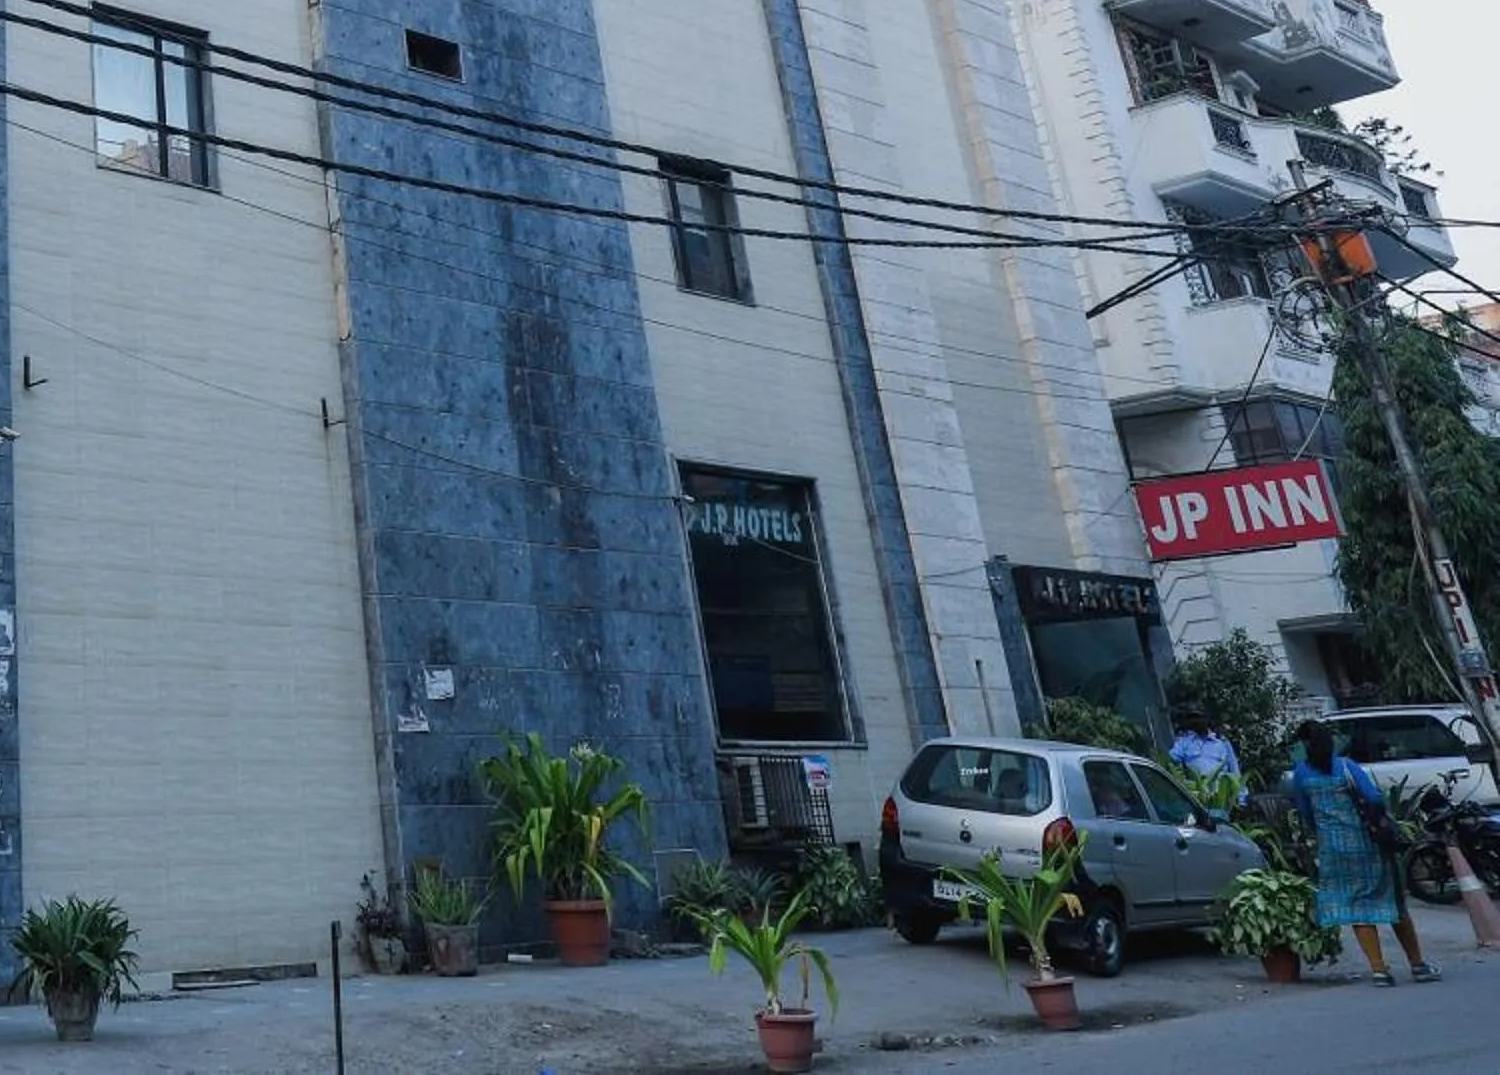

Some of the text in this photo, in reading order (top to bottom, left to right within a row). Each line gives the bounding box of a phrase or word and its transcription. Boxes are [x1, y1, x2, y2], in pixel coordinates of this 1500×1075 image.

[733, 505, 802, 542] HOTELS
[1151, 475, 1329, 543] JP INN
